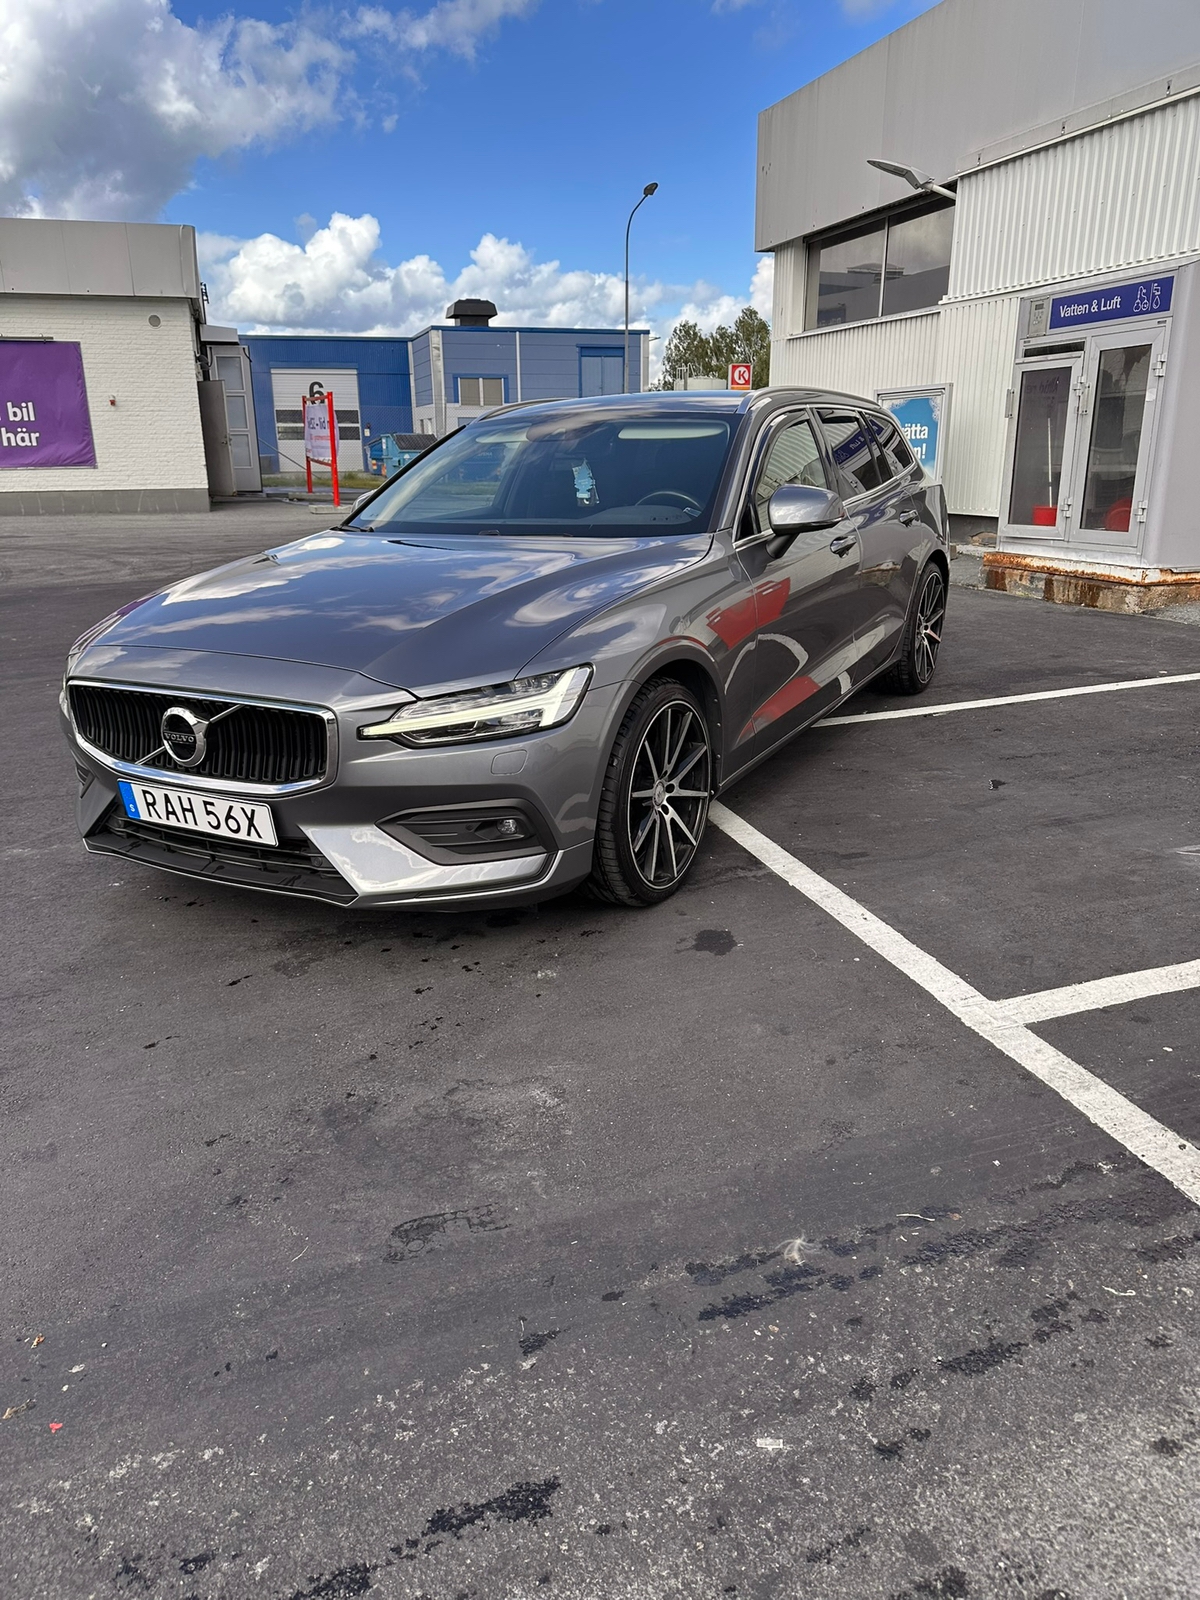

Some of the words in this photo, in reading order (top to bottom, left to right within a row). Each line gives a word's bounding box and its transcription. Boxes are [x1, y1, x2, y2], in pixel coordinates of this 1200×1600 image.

[1059, 303, 1089, 318] Vatten
[1090, 299, 1099, 313] &
[1100, 295, 1122, 311] Luft
[738, 369, 747, 383] K
[308, 381, 326, 406] 6
[6, 401, 36, 422] bil
[0, 427, 40, 447] här
[901, 423, 929, 440] ätta
[163, 732, 195, 743] VOLVO
[129, 804, 136, 812] S
[141, 789, 199, 827] RAH
[202, 799, 263, 840] 56X
